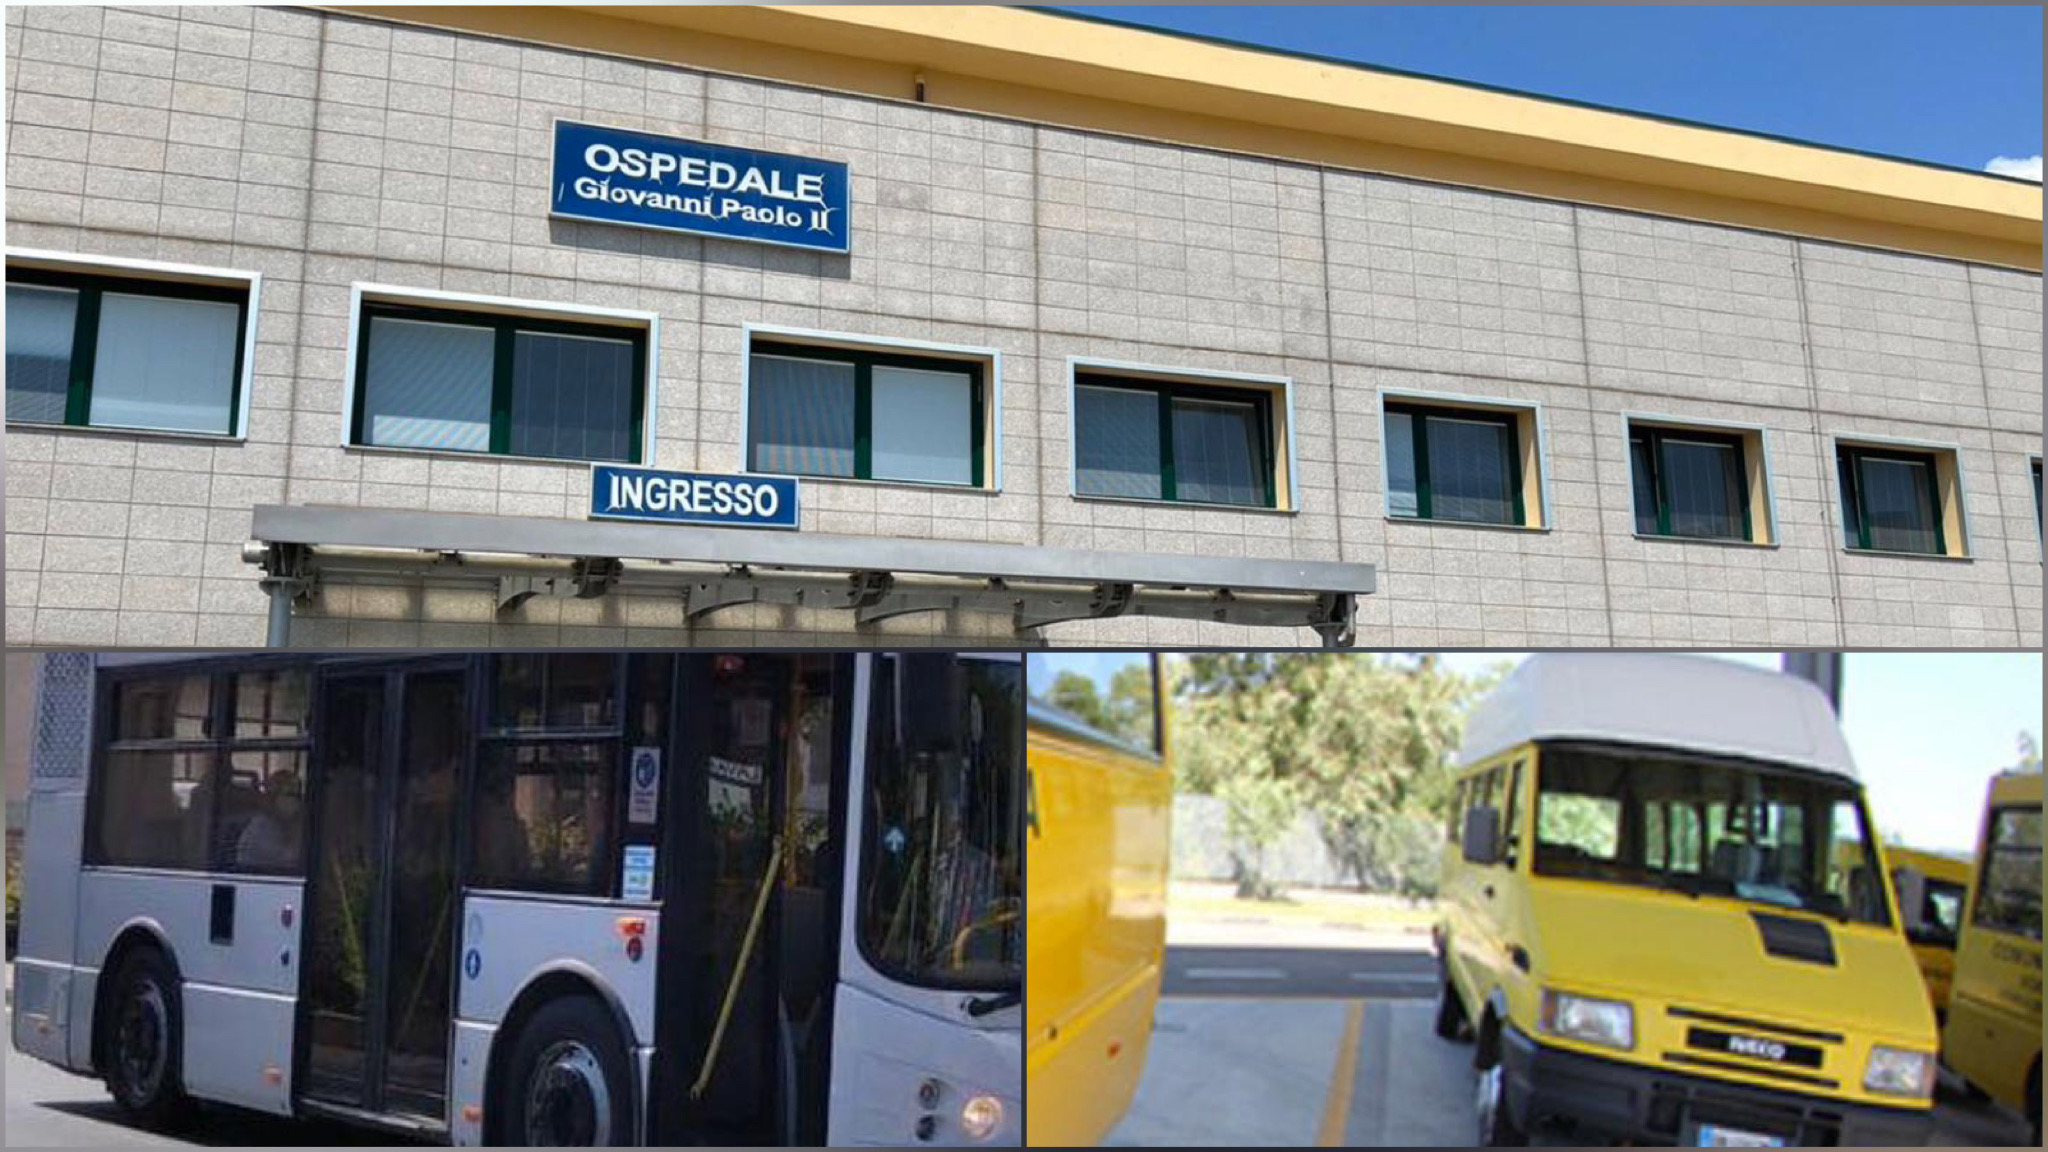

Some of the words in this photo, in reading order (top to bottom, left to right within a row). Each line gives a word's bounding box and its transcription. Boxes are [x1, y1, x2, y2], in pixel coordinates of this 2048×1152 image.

[584, 143, 824, 203] OSPEDALE
[573, 176, 713, 218] Giovanni
[720, 197, 803, 228] Paolo
[609, 473, 779, 517] INGRESSO
[1729, 1035, 1786, 1060] IVECO
